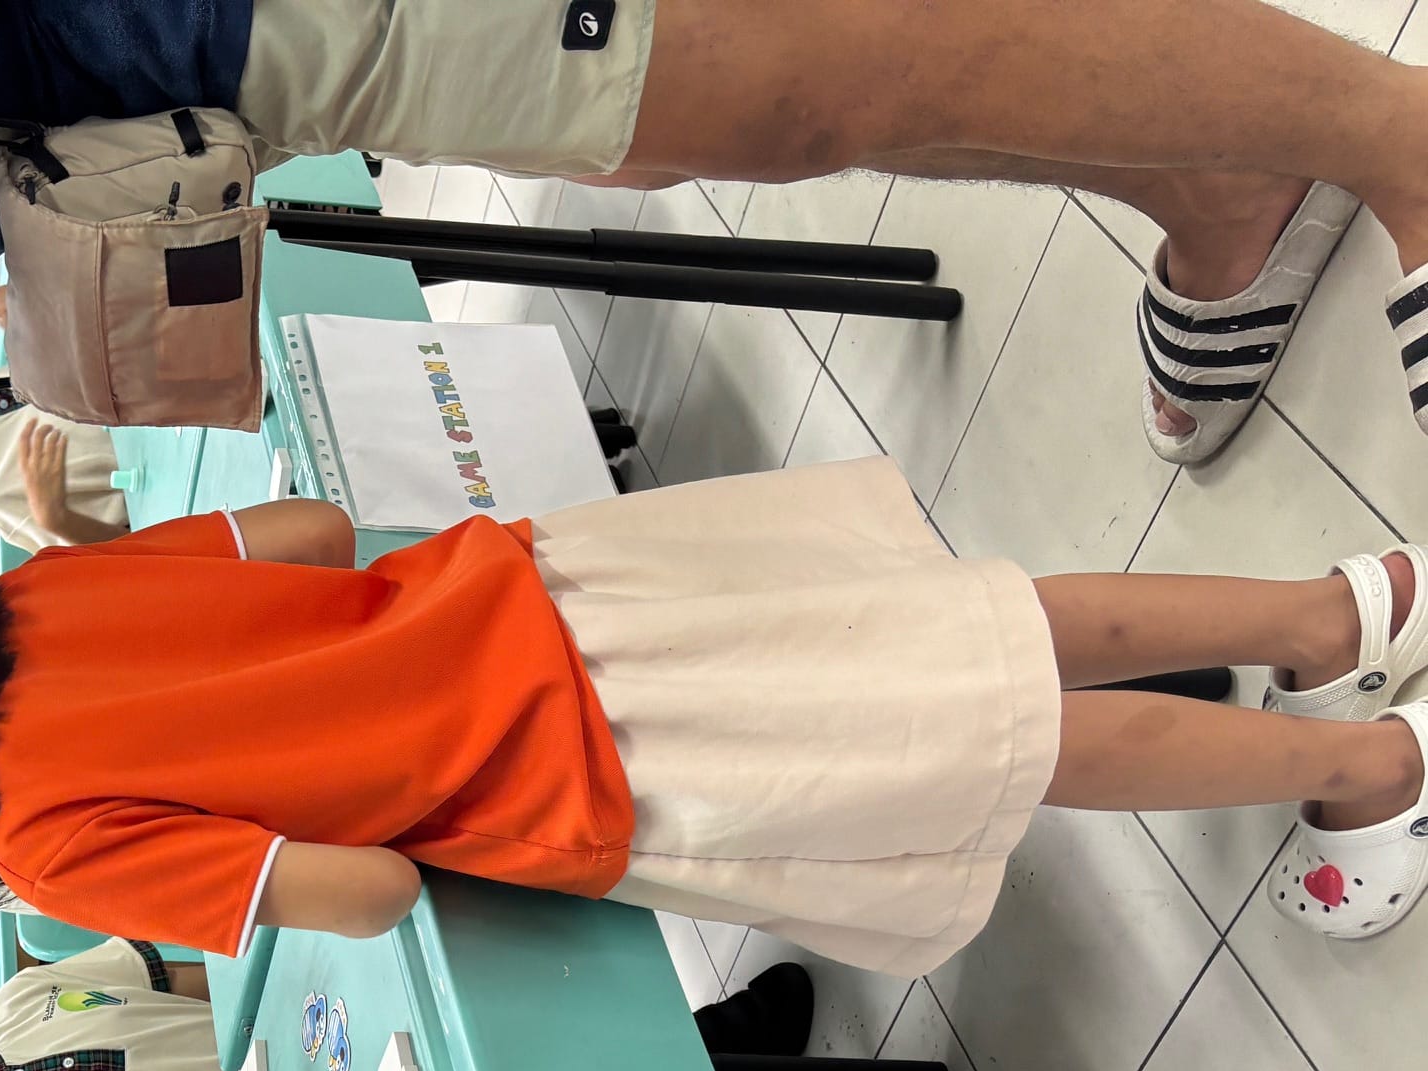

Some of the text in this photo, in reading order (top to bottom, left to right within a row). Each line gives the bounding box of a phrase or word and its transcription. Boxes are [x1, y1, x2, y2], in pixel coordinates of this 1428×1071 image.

[417, 342, 496, 508] GAME STATION 1
